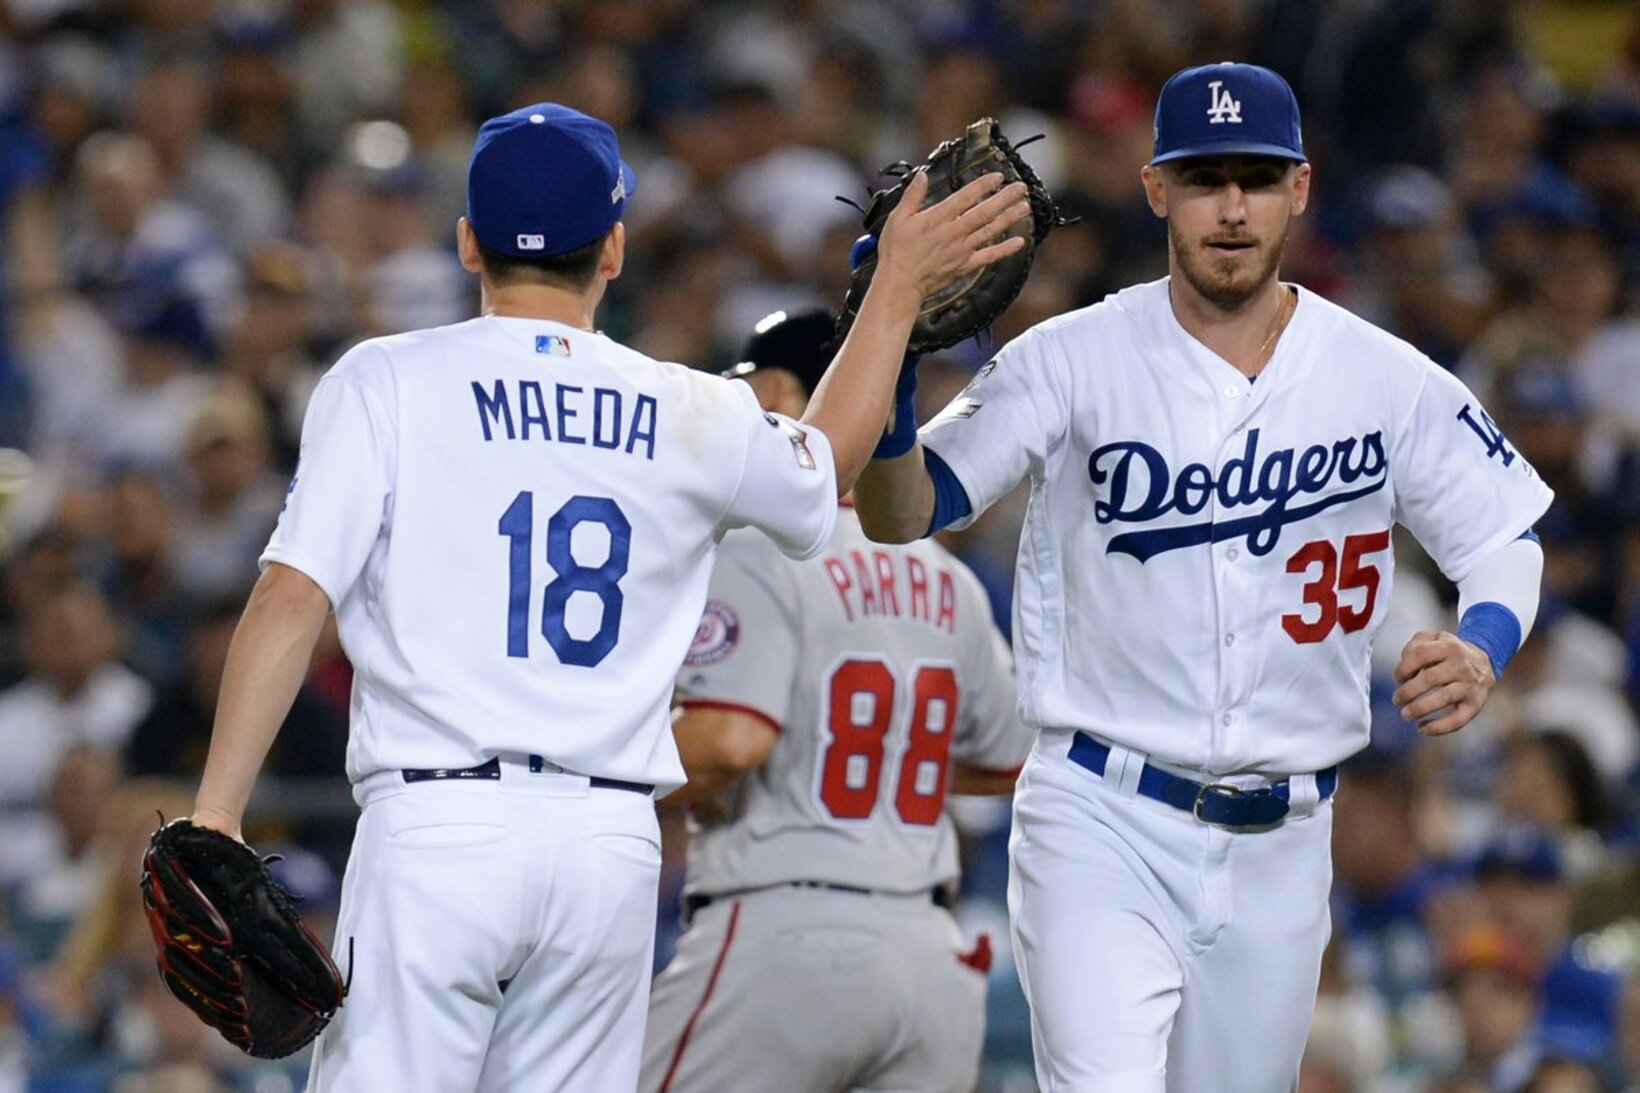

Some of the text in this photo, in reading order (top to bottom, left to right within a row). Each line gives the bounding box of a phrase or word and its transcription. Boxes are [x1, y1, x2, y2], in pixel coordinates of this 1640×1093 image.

[1206, 80, 1243, 124] LA
[470, 379, 658, 460] MAEDA
[1088, 428, 1388, 561] Dodgers
[498, 490, 633, 668] 18
[823, 549, 956, 634] PARRA
[1281, 529, 1390, 645] 35
[817, 656, 960, 828] 88
